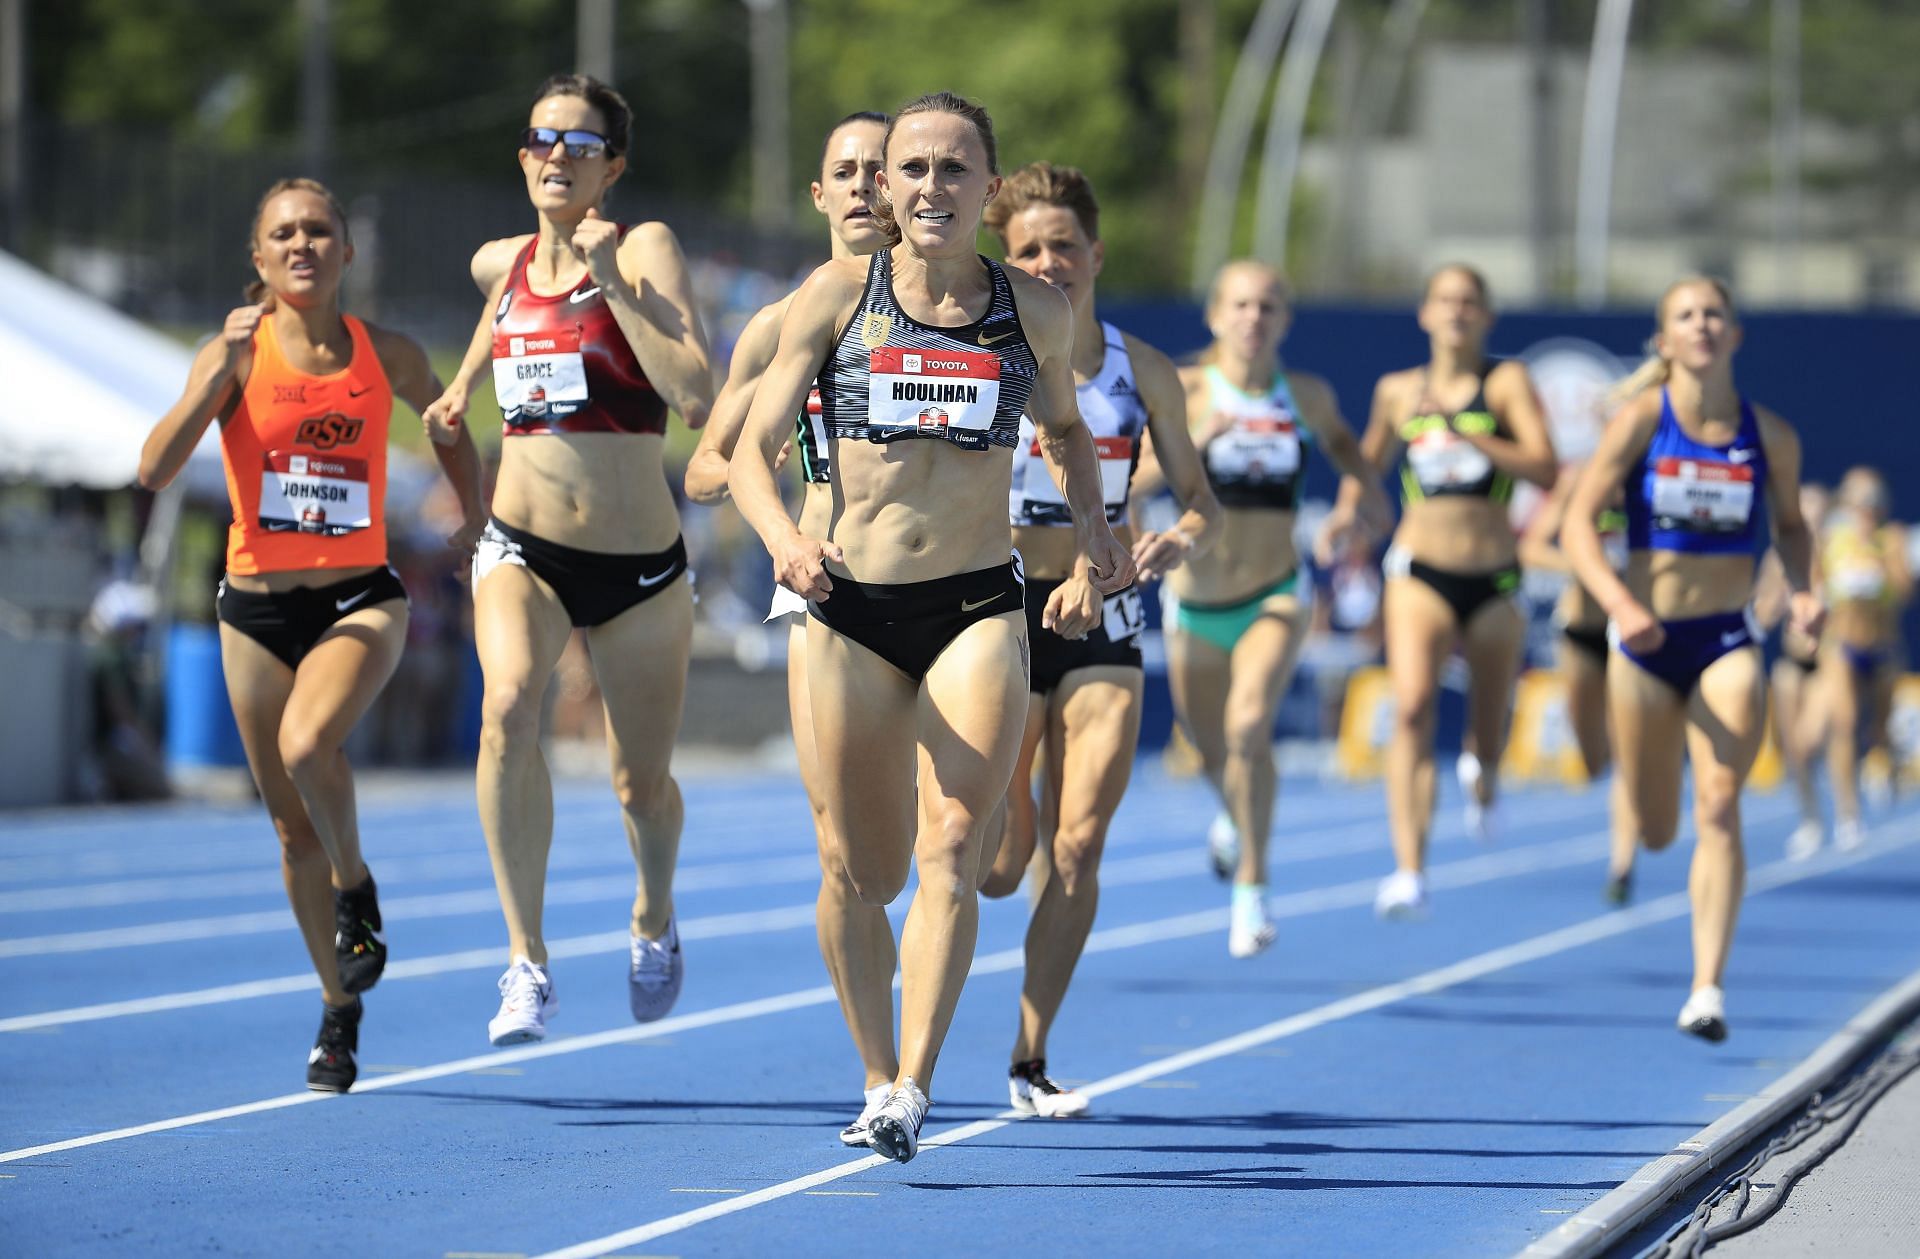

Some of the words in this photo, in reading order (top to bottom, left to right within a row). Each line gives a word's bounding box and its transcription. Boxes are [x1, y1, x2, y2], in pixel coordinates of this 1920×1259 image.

[525, 339, 556, 351] TOYOTA
[517, 362, 553, 380] GRACE
[925, 360, 969, 371] TOYOTA
[892, 382, 978, 404] HOULIHAN
[294, 413, 365, 450] OSU
[310, 461, 346, 474] TOYOTA
[283, 481, 348, 503] JOHNSON
